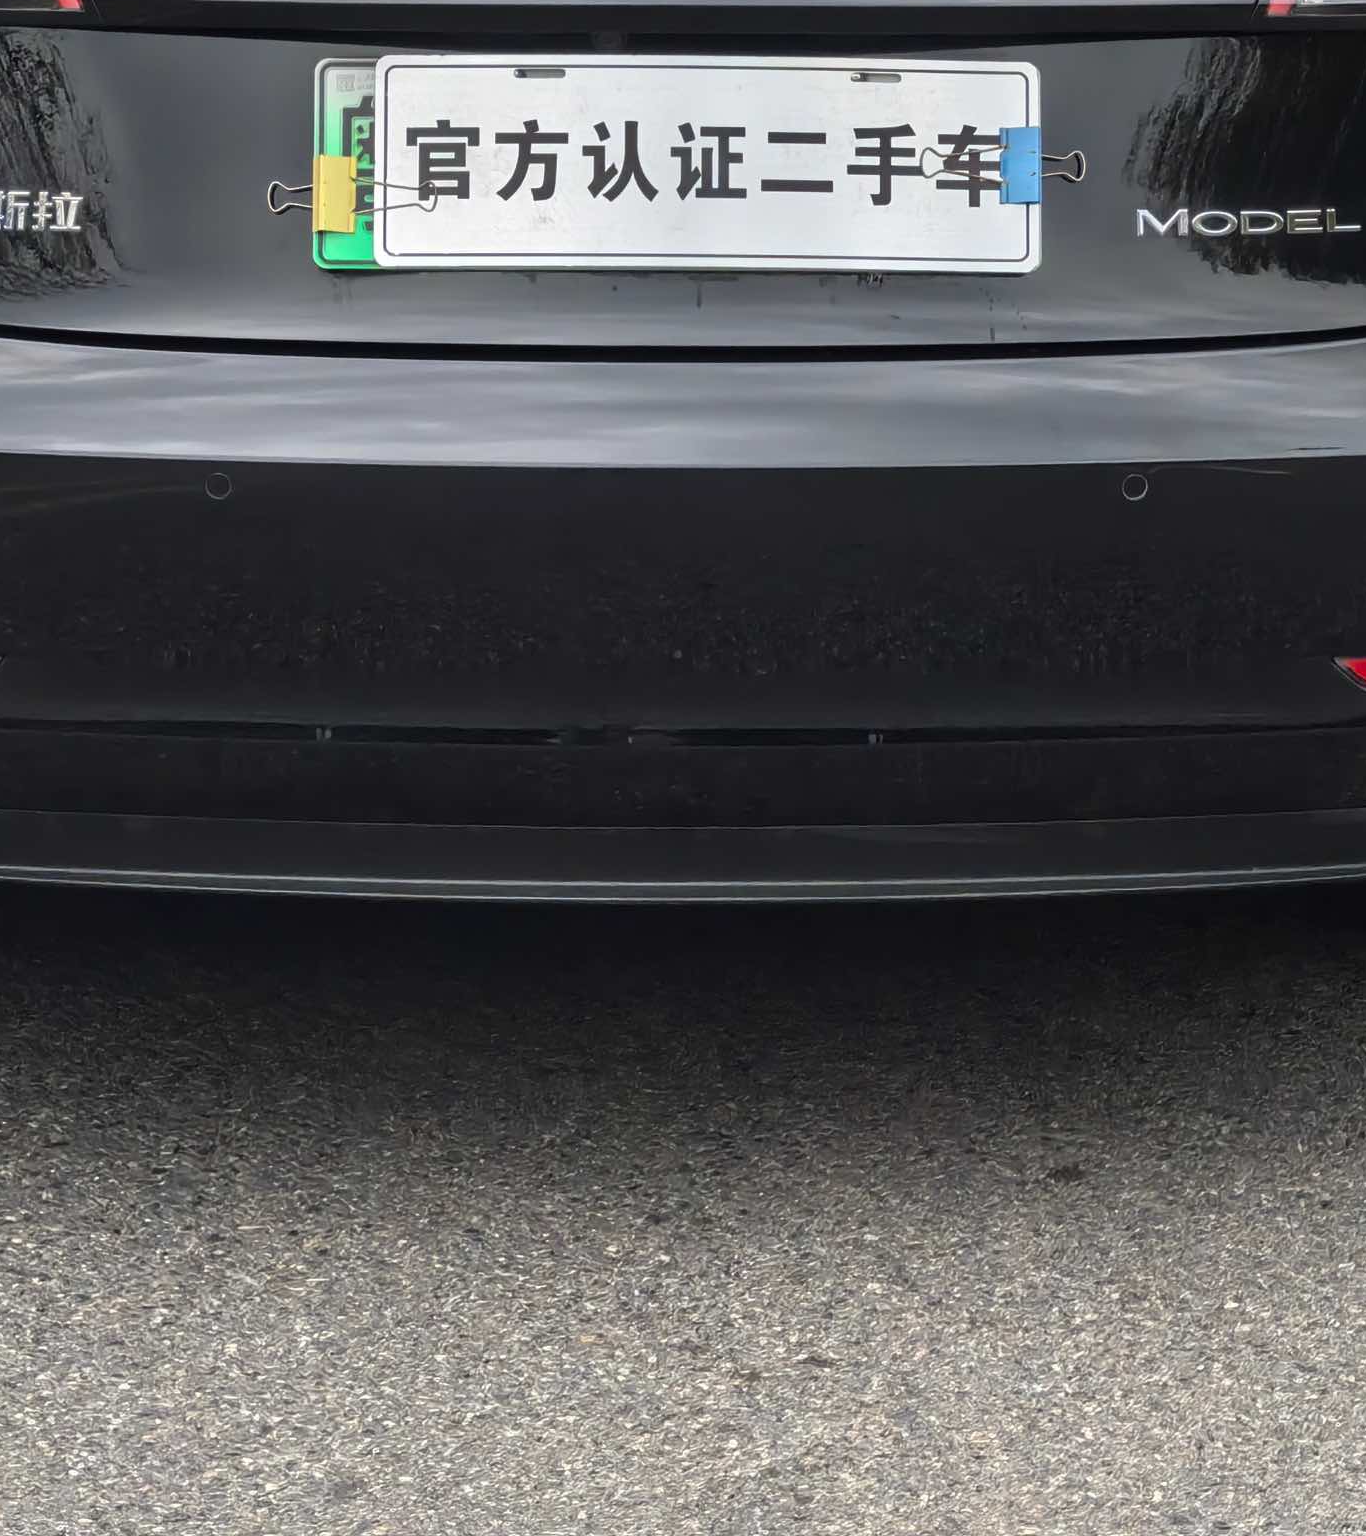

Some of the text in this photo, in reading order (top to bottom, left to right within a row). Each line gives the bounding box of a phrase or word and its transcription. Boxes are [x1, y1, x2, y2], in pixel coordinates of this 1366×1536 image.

[406, 120, 1001, 207] 官方认证二手车
